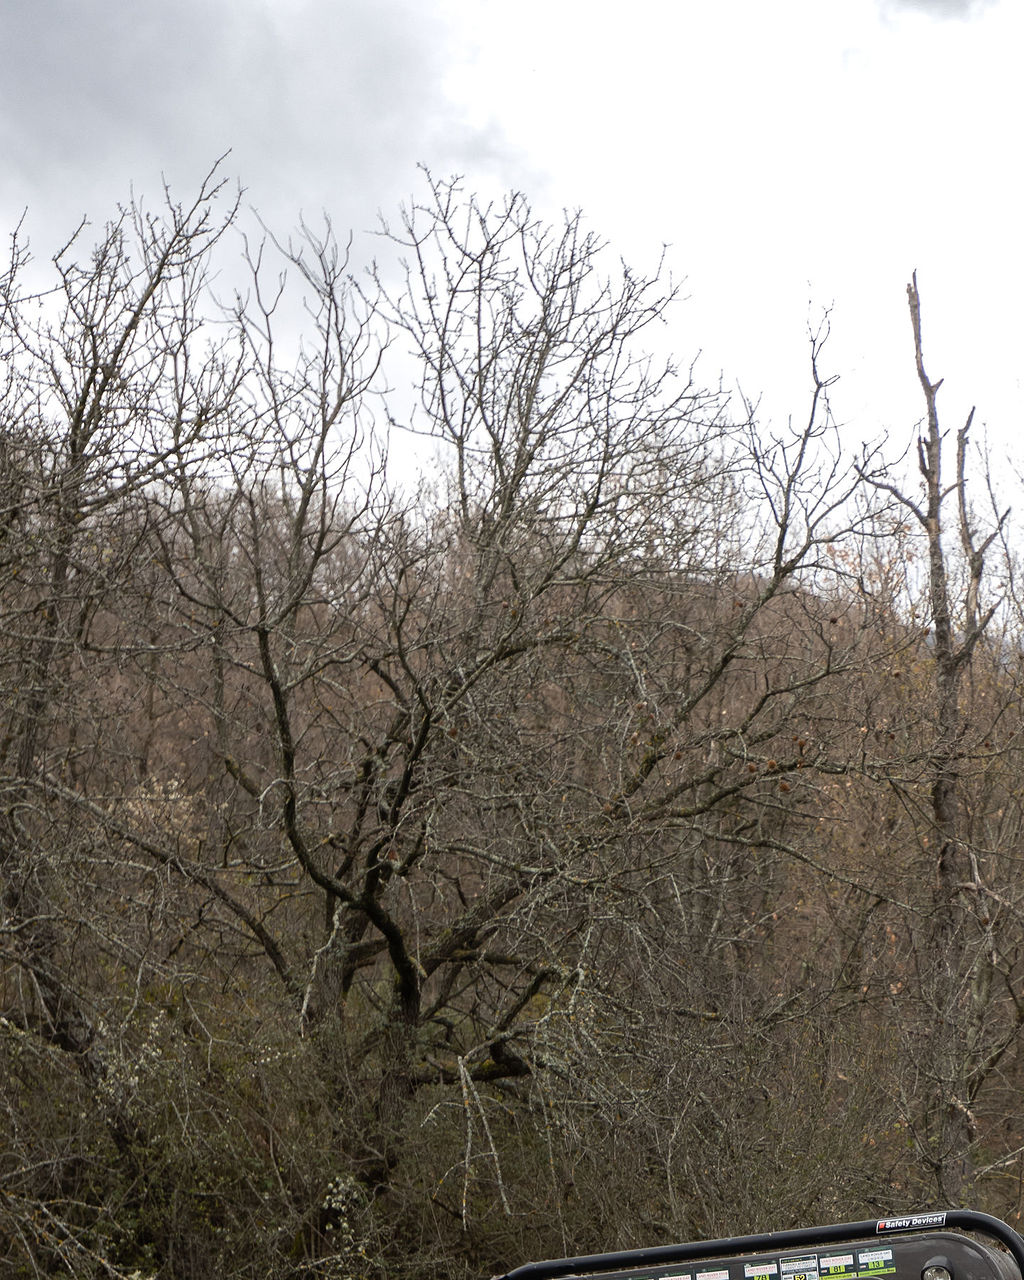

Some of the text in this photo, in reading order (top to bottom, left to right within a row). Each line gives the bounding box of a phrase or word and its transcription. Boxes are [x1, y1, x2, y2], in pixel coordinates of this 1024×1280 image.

[885, 1215, 942, 1229] Safety Devices
[833, 1265, 842, 1273] 81
